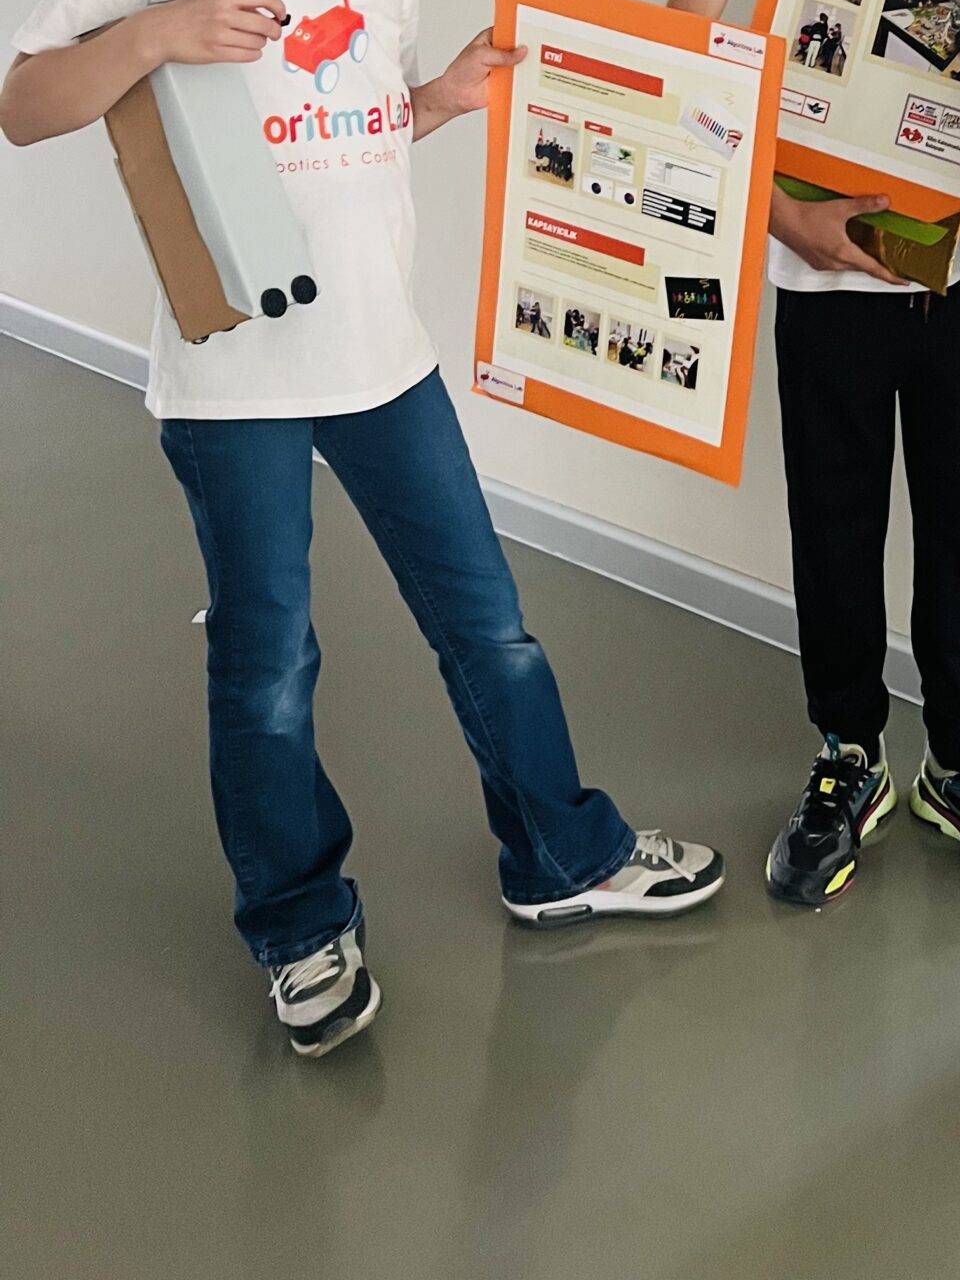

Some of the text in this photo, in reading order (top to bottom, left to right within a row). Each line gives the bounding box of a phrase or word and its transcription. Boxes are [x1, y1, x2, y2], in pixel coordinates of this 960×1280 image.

[386, 92, 410, 132] Lab
[340, 154, 350, 166] &
[527, 217, 577, 240] KAPSAYICILIK
